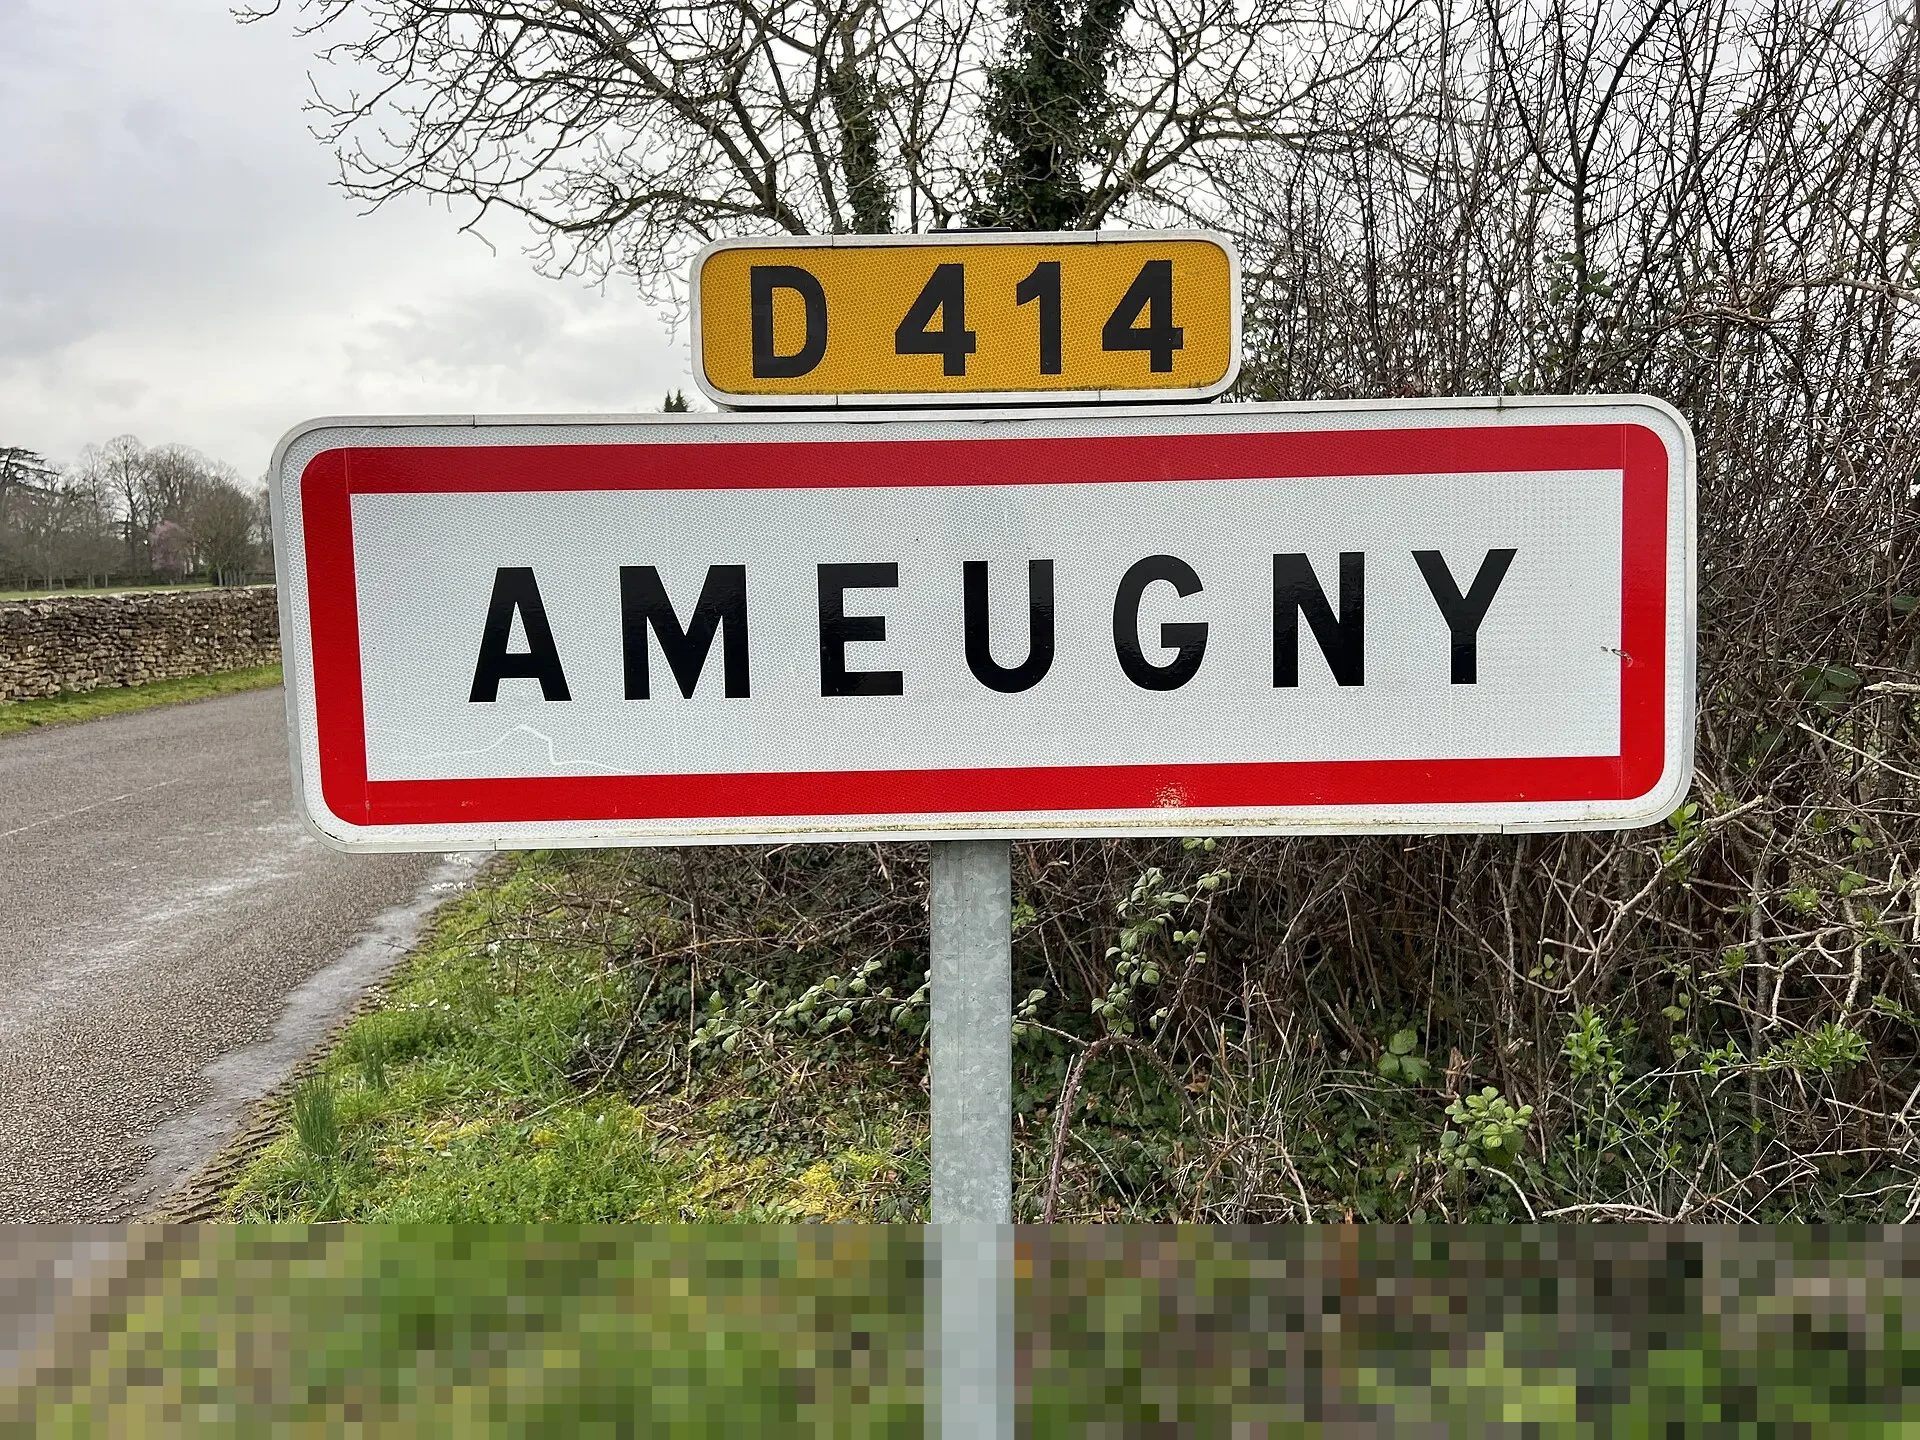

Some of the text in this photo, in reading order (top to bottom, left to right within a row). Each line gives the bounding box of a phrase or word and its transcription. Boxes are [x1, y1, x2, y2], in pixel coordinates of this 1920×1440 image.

[749, 259, 1184, 379] D 414
[468, 548, 1518, 703] AMEUGNY
